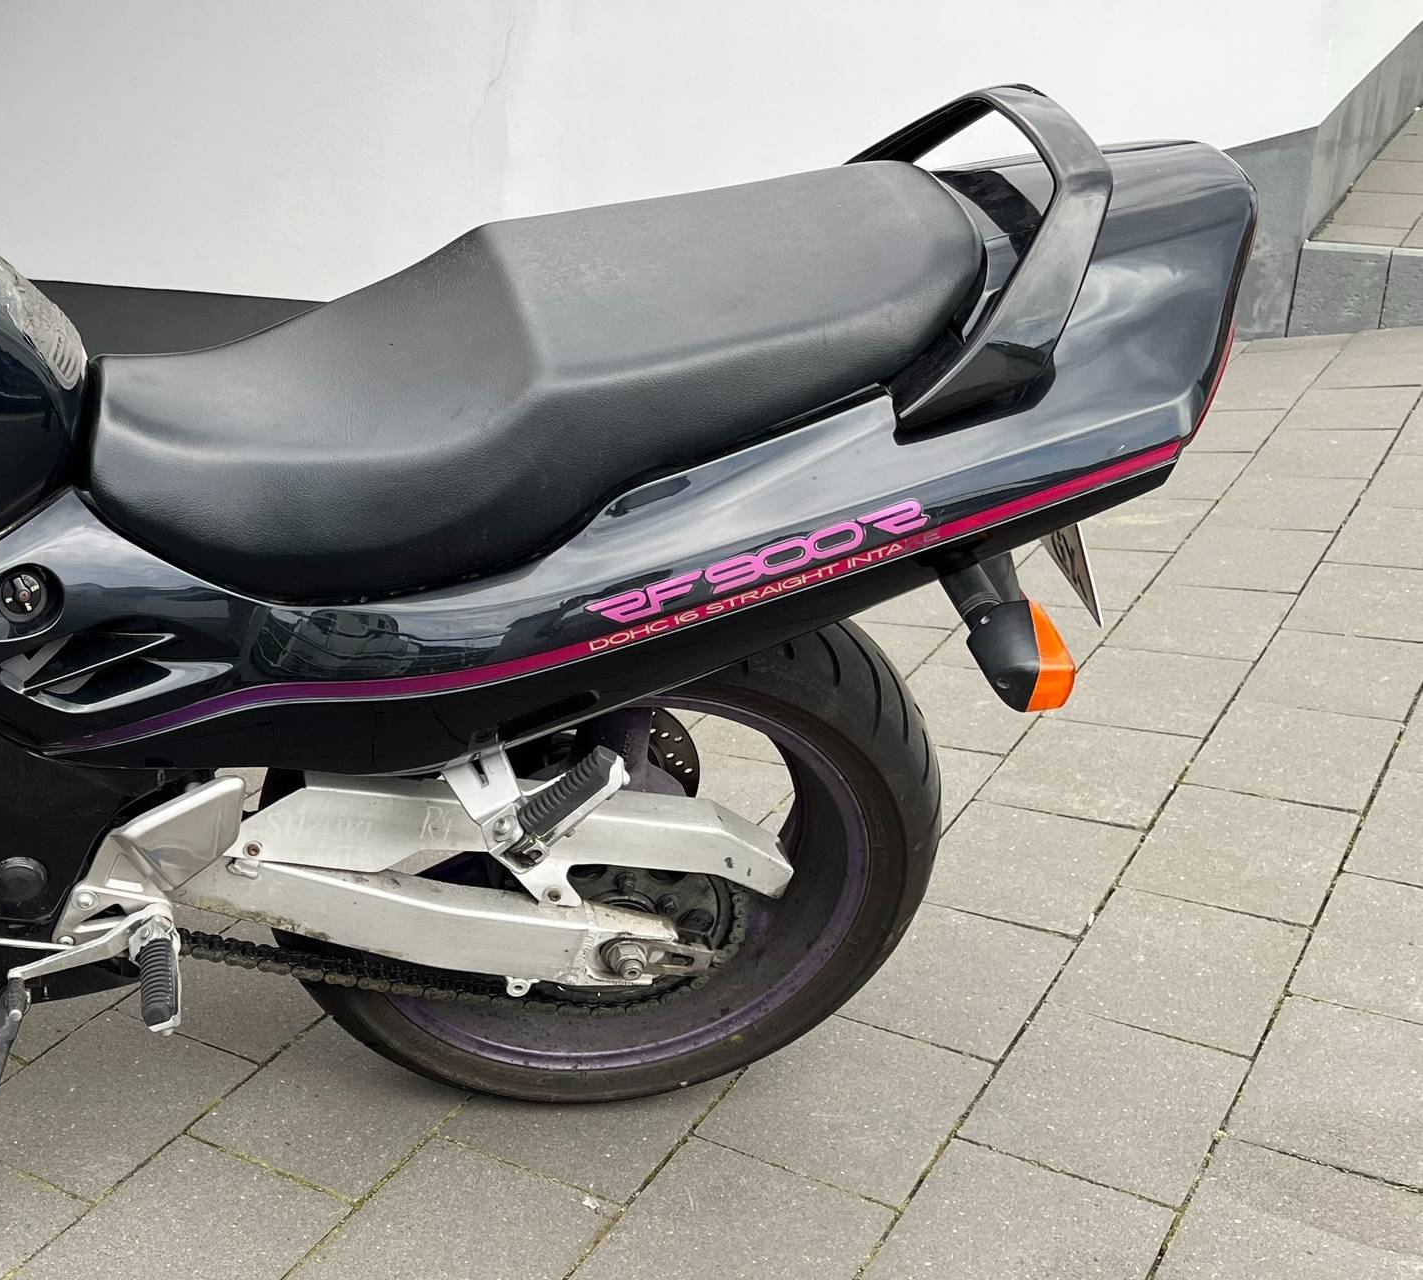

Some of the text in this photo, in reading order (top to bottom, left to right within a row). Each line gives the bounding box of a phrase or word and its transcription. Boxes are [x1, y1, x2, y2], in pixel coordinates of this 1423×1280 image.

[588, 530, 941, 652] DOHC 16 STRAIGHT INTAE
